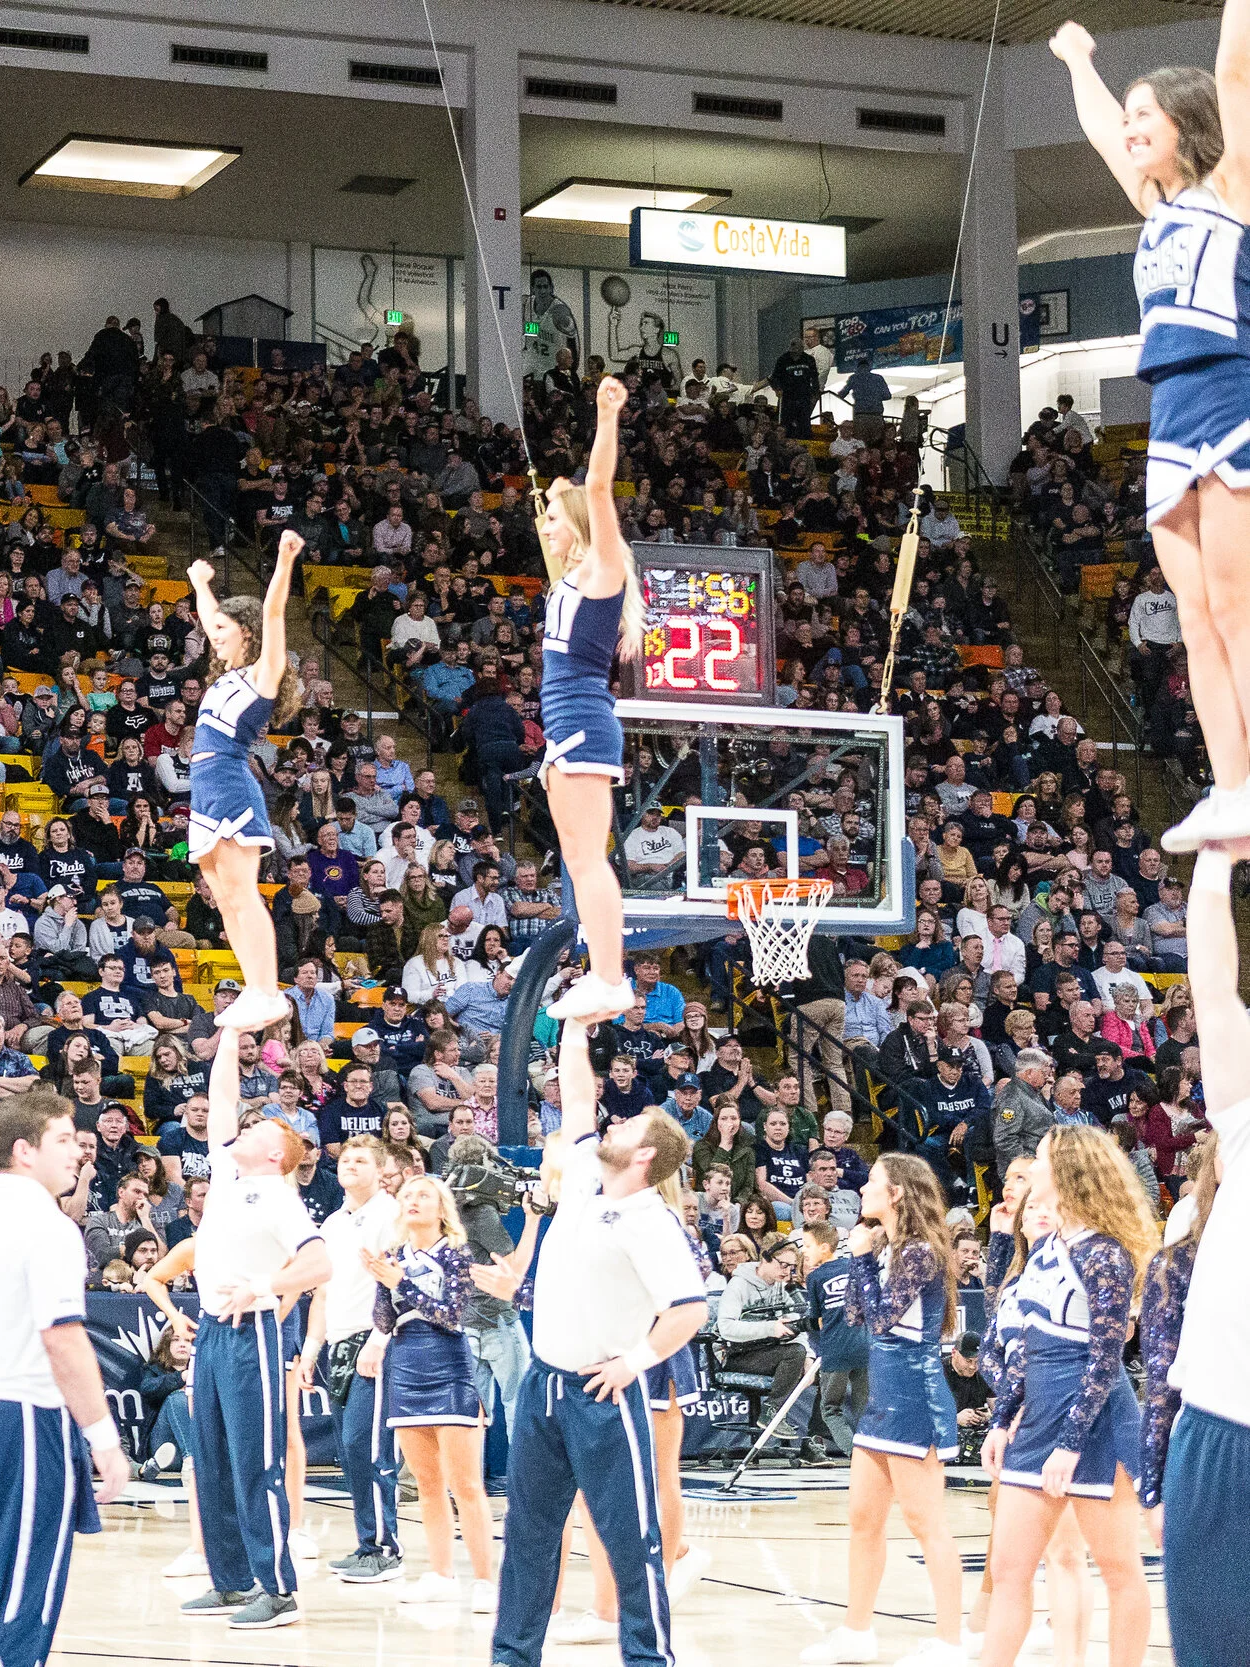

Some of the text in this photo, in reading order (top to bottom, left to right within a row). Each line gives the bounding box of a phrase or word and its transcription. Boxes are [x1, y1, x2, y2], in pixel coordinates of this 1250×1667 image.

[492, 285, 511, 311] T
[387, 310, 403, 323] EXIT
[908, 310, 938, 330] TOP
[663, 332, 678, 345] EXIT
[991, 322, 1008, 347] U
[687, 573, 750, 615] 1:56
[664, 617, 741, 691] 22
[56, 859, 85, 876] State
[955, 1098, 975, 1111] STATE
[782, 1165, 793, 1177] 6
[682, 1393, 750, 1420] ospita
